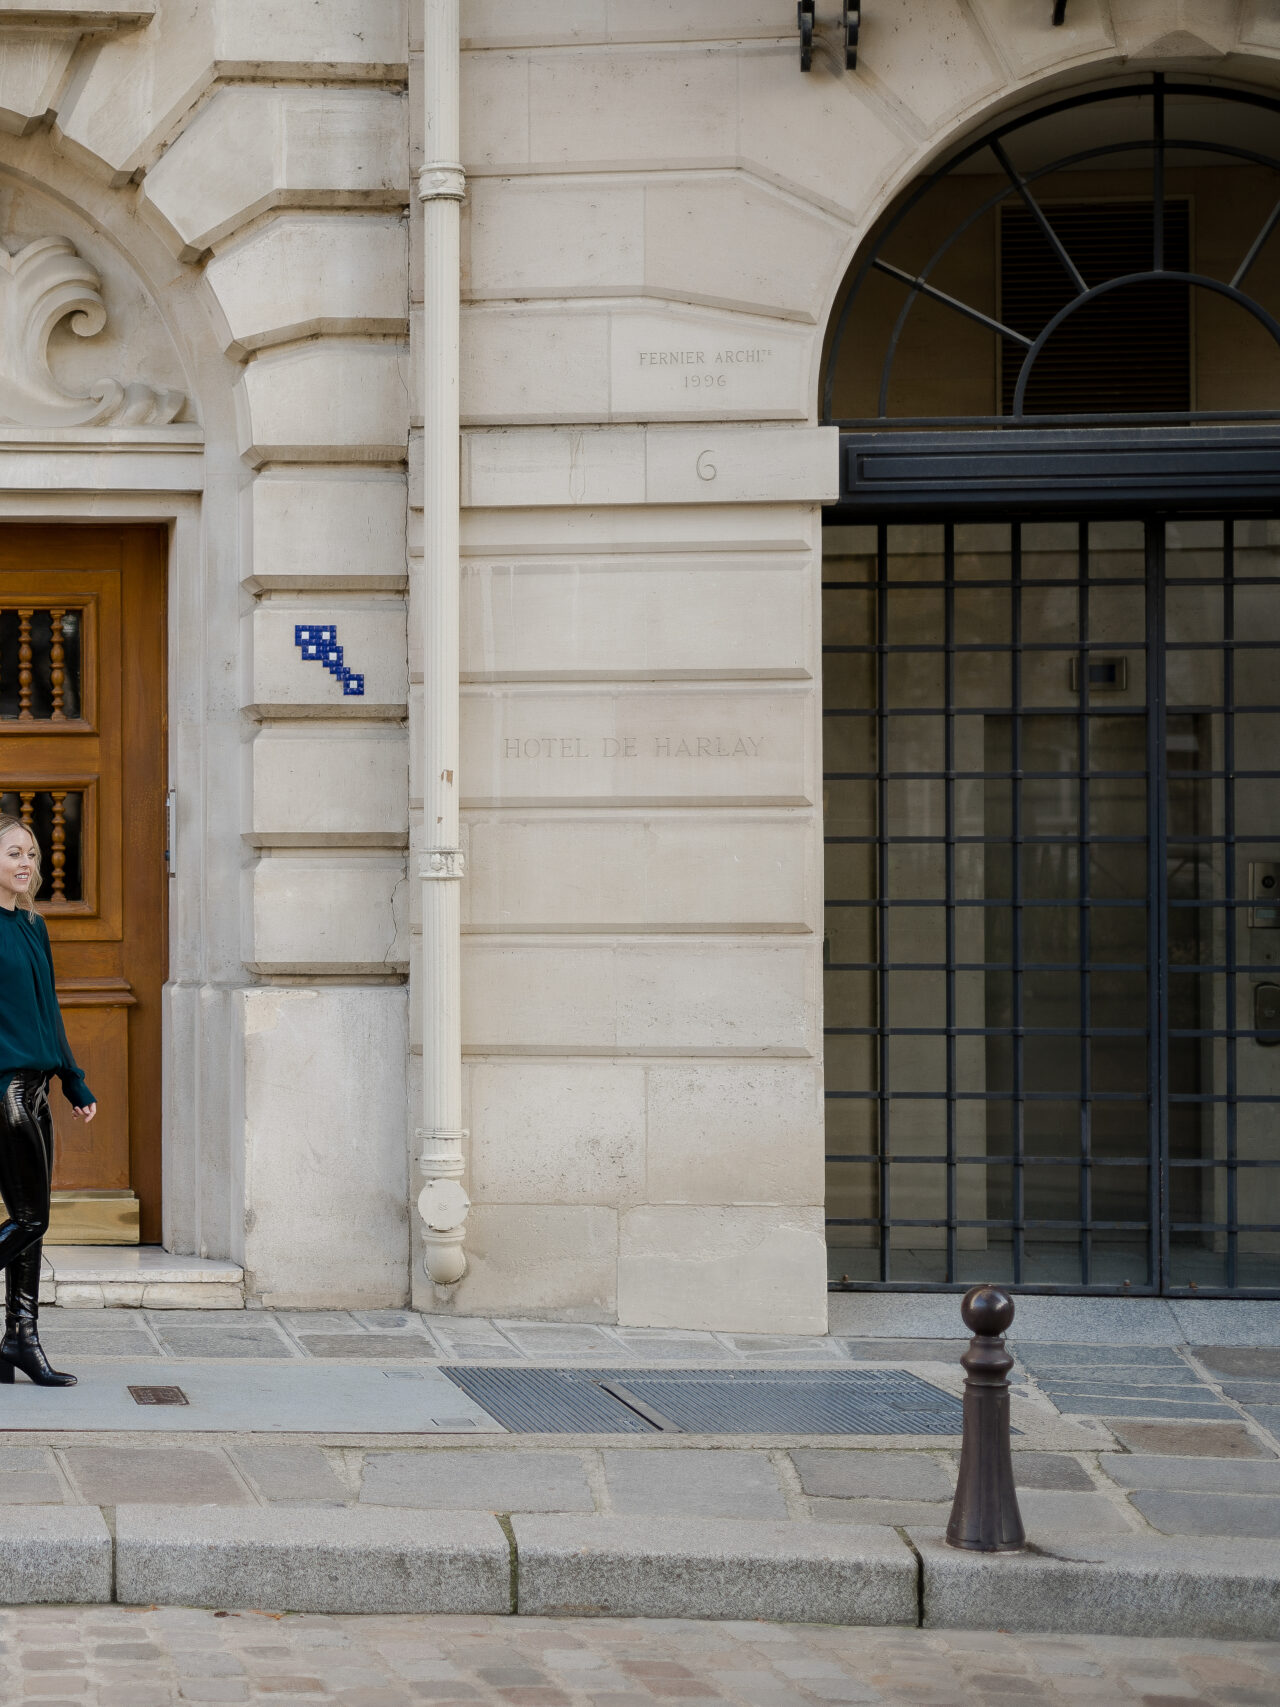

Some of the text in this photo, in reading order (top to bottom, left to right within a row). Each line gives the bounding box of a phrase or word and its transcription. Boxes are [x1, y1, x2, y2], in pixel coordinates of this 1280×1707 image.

[638, 350, 706, 367] FERNIER
[683, 373, 728, 389] 1996
[695, 449, 718, 482] 6
[502, 735, 766, 760] HOTEL DE HARLAY
